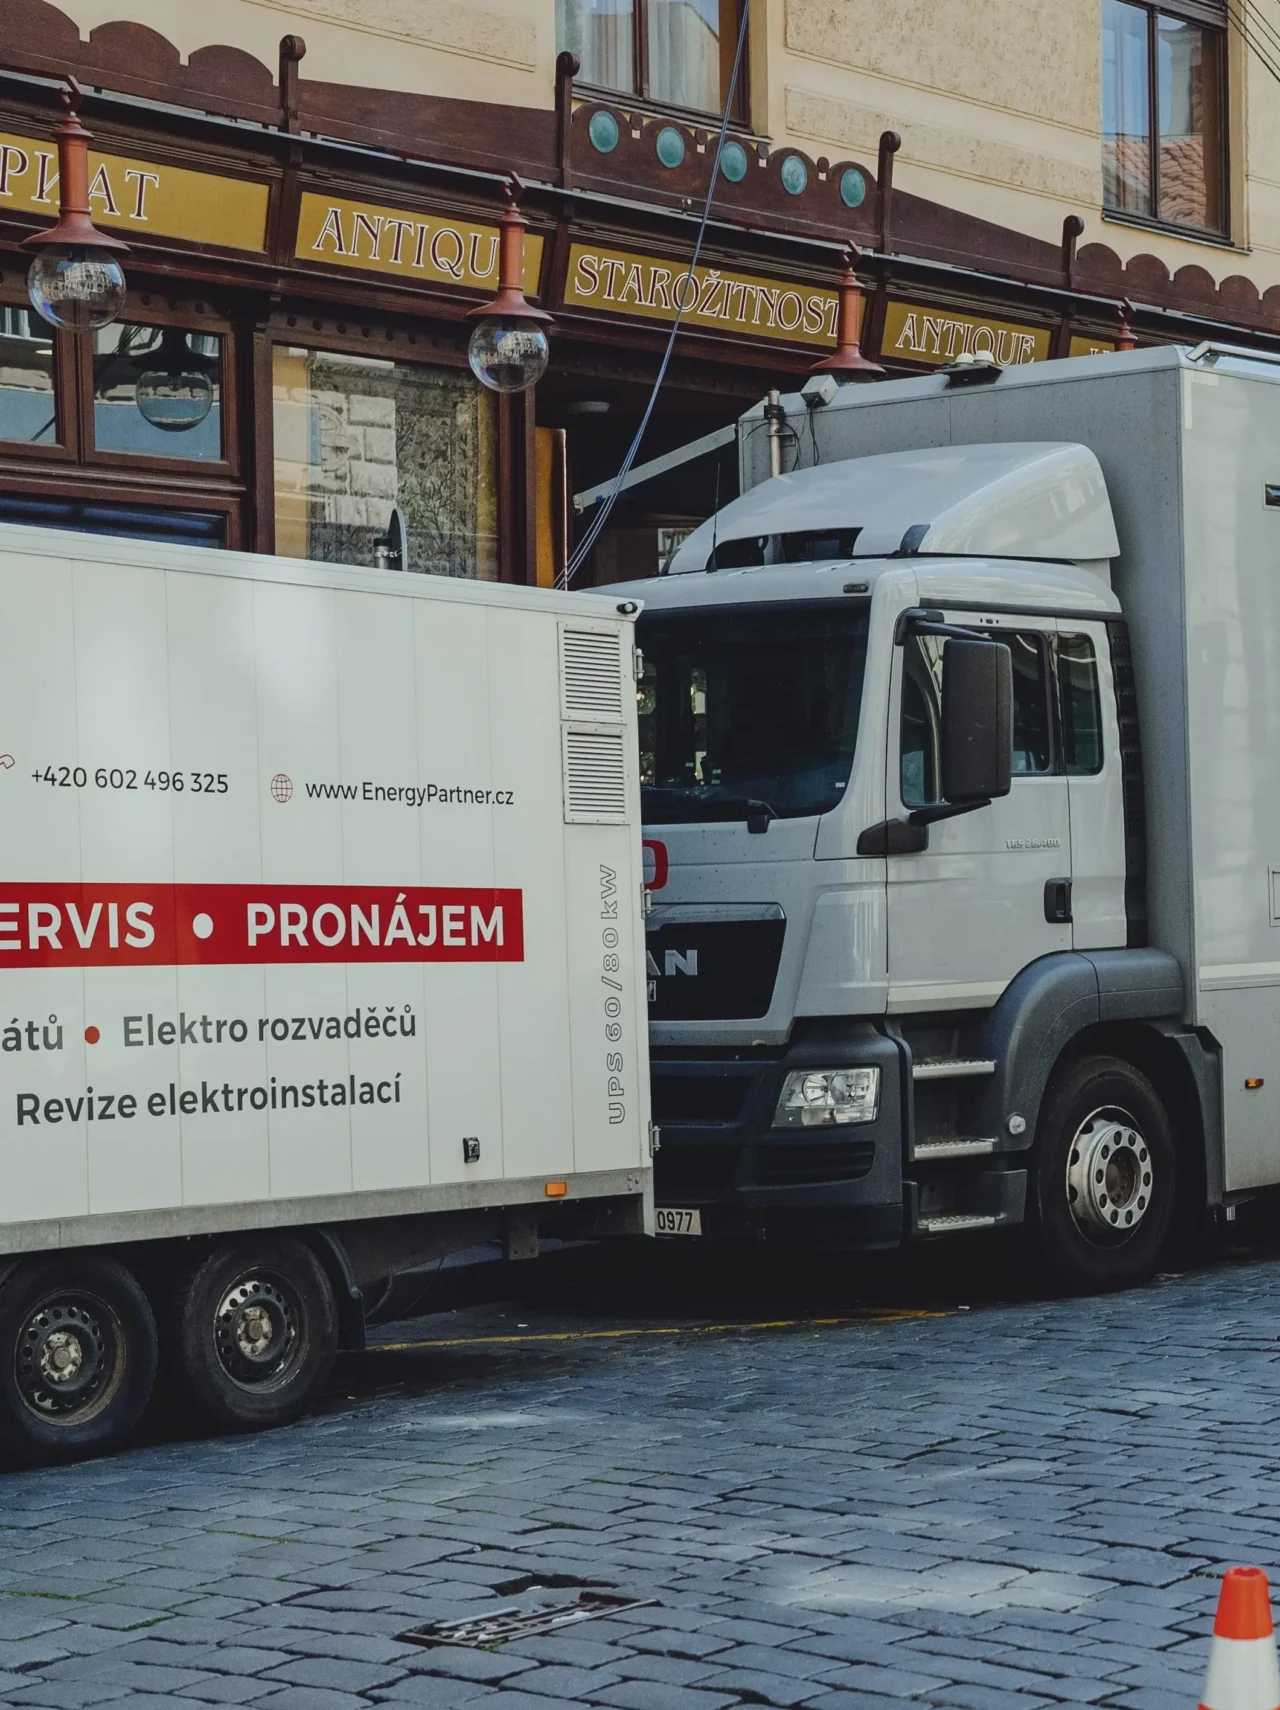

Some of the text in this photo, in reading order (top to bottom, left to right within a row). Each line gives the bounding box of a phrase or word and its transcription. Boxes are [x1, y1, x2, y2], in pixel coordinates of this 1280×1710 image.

[312, 207, 525, 281] ANTIQU
[574, 254, 839, 338] STAROŽITNOST
[31, 766, 229, 794] +420 602 496 325
[362, 782, 515, 807] EnergyPartner.cz
[246, 892, 505, 948] PRONÁJEM
[1, 1004, 416, 1052] átů Elektro rozvaděčů
[16, 1072, 402, 1126] Revize elektroinstalací
[606, 1052, 626, 1125] UPS
[657, 1210, 693, 1232] 0977
